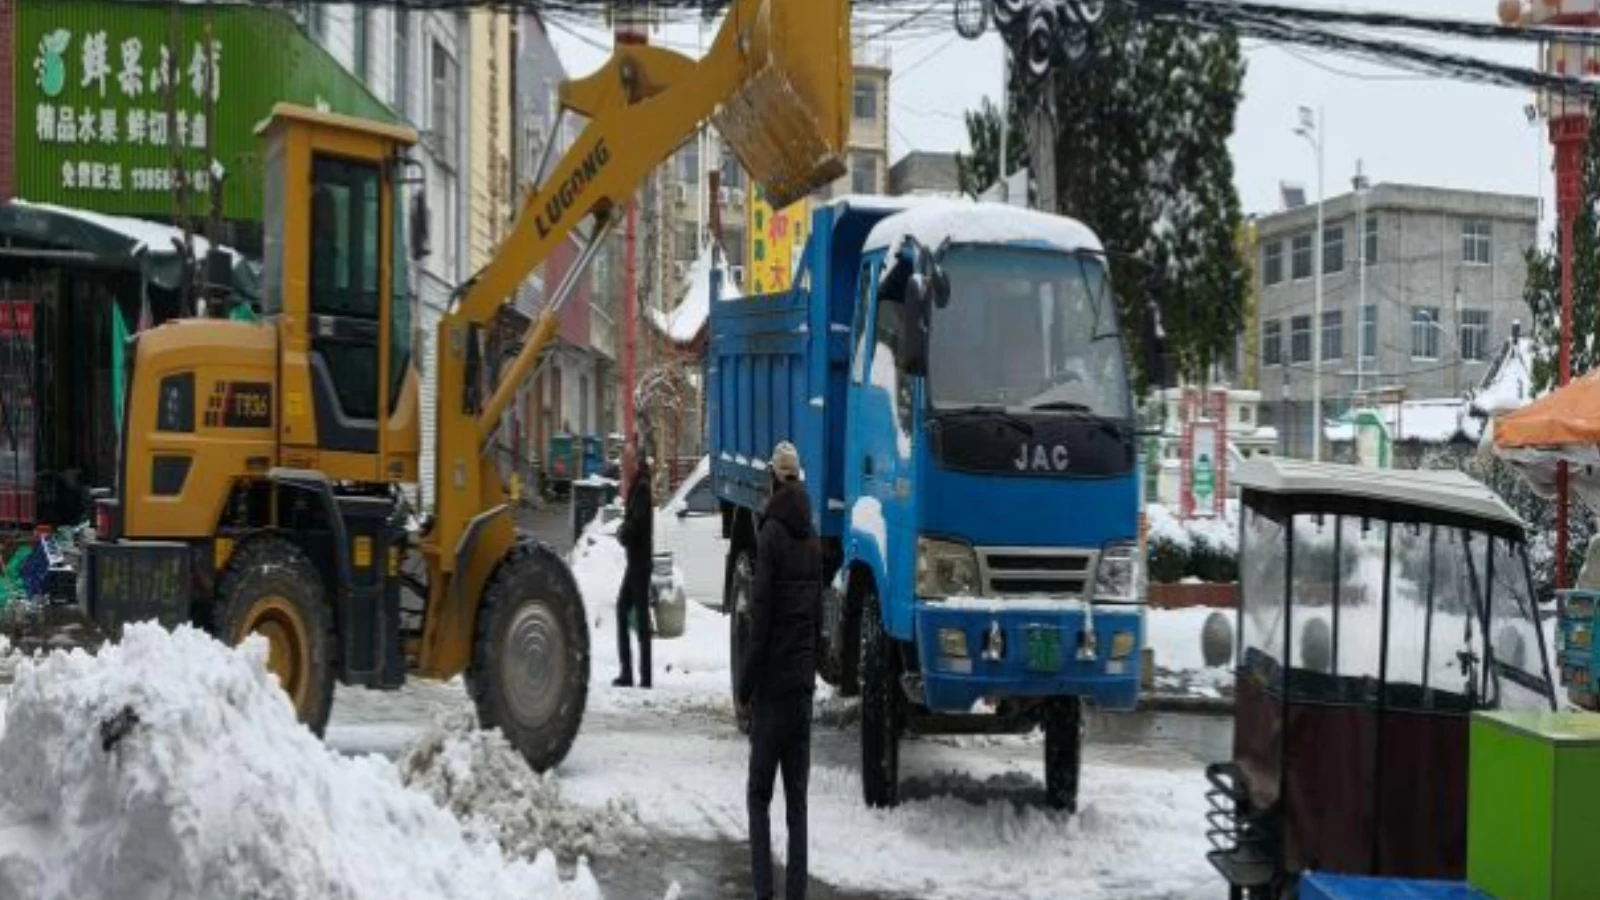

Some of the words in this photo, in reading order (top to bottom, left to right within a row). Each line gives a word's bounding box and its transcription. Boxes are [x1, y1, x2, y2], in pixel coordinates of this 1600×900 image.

[36, 103, 119, 144] 精品水果
[61, 160, 122, 190] 免费配送
[534, 136, 610, 240] LUGONG
[1013, 442, 1069, 471] JAC
